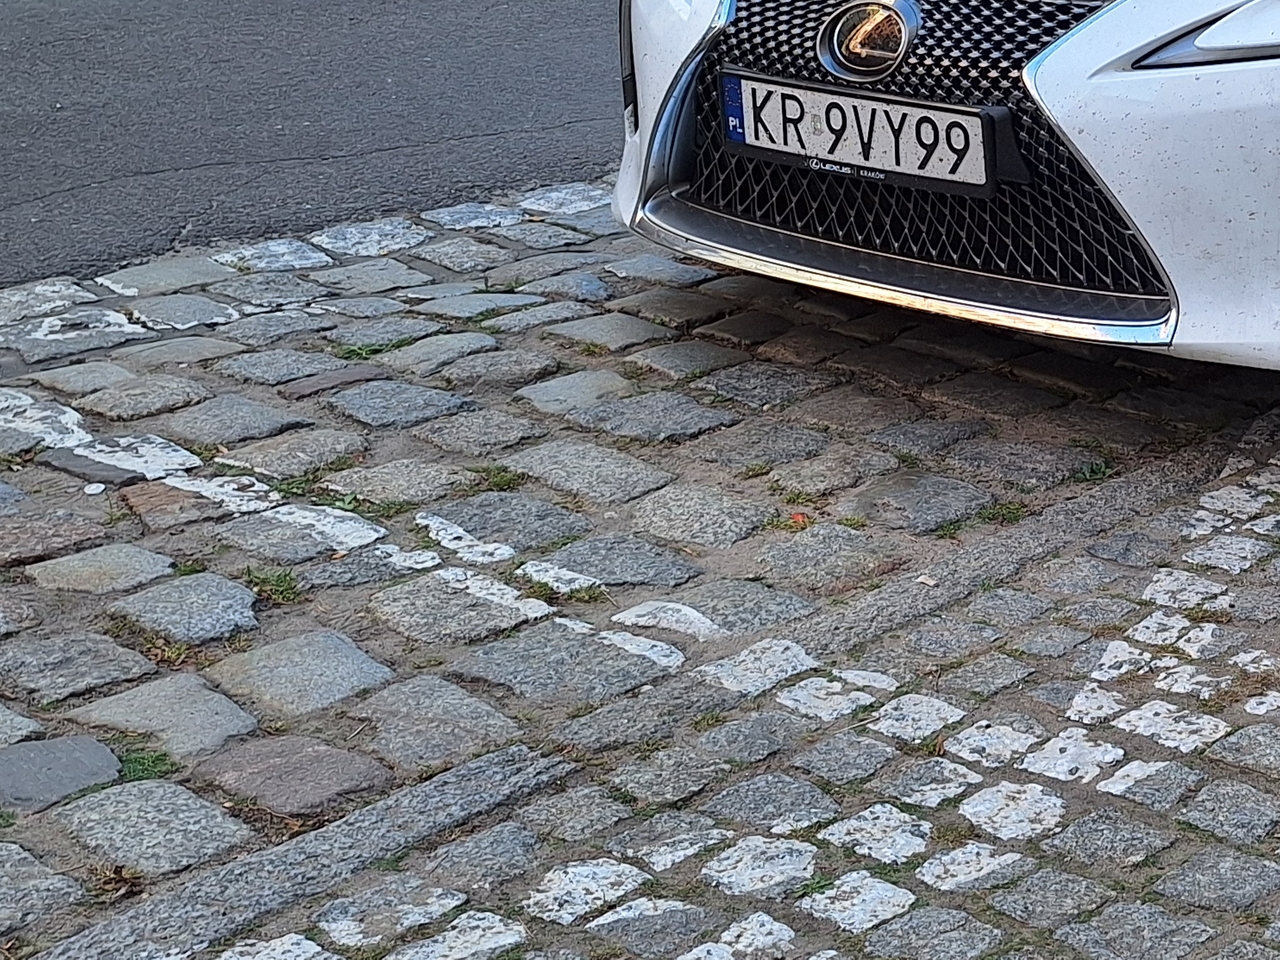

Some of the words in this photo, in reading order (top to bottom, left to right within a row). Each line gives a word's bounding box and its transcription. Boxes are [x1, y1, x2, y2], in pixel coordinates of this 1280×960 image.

[728, 116, 744, 133] PL
[750, 87, 806, 150] KR
[825, 101, 970, 175] 9VY99
[820, 162, 852, 174] LEXUS
